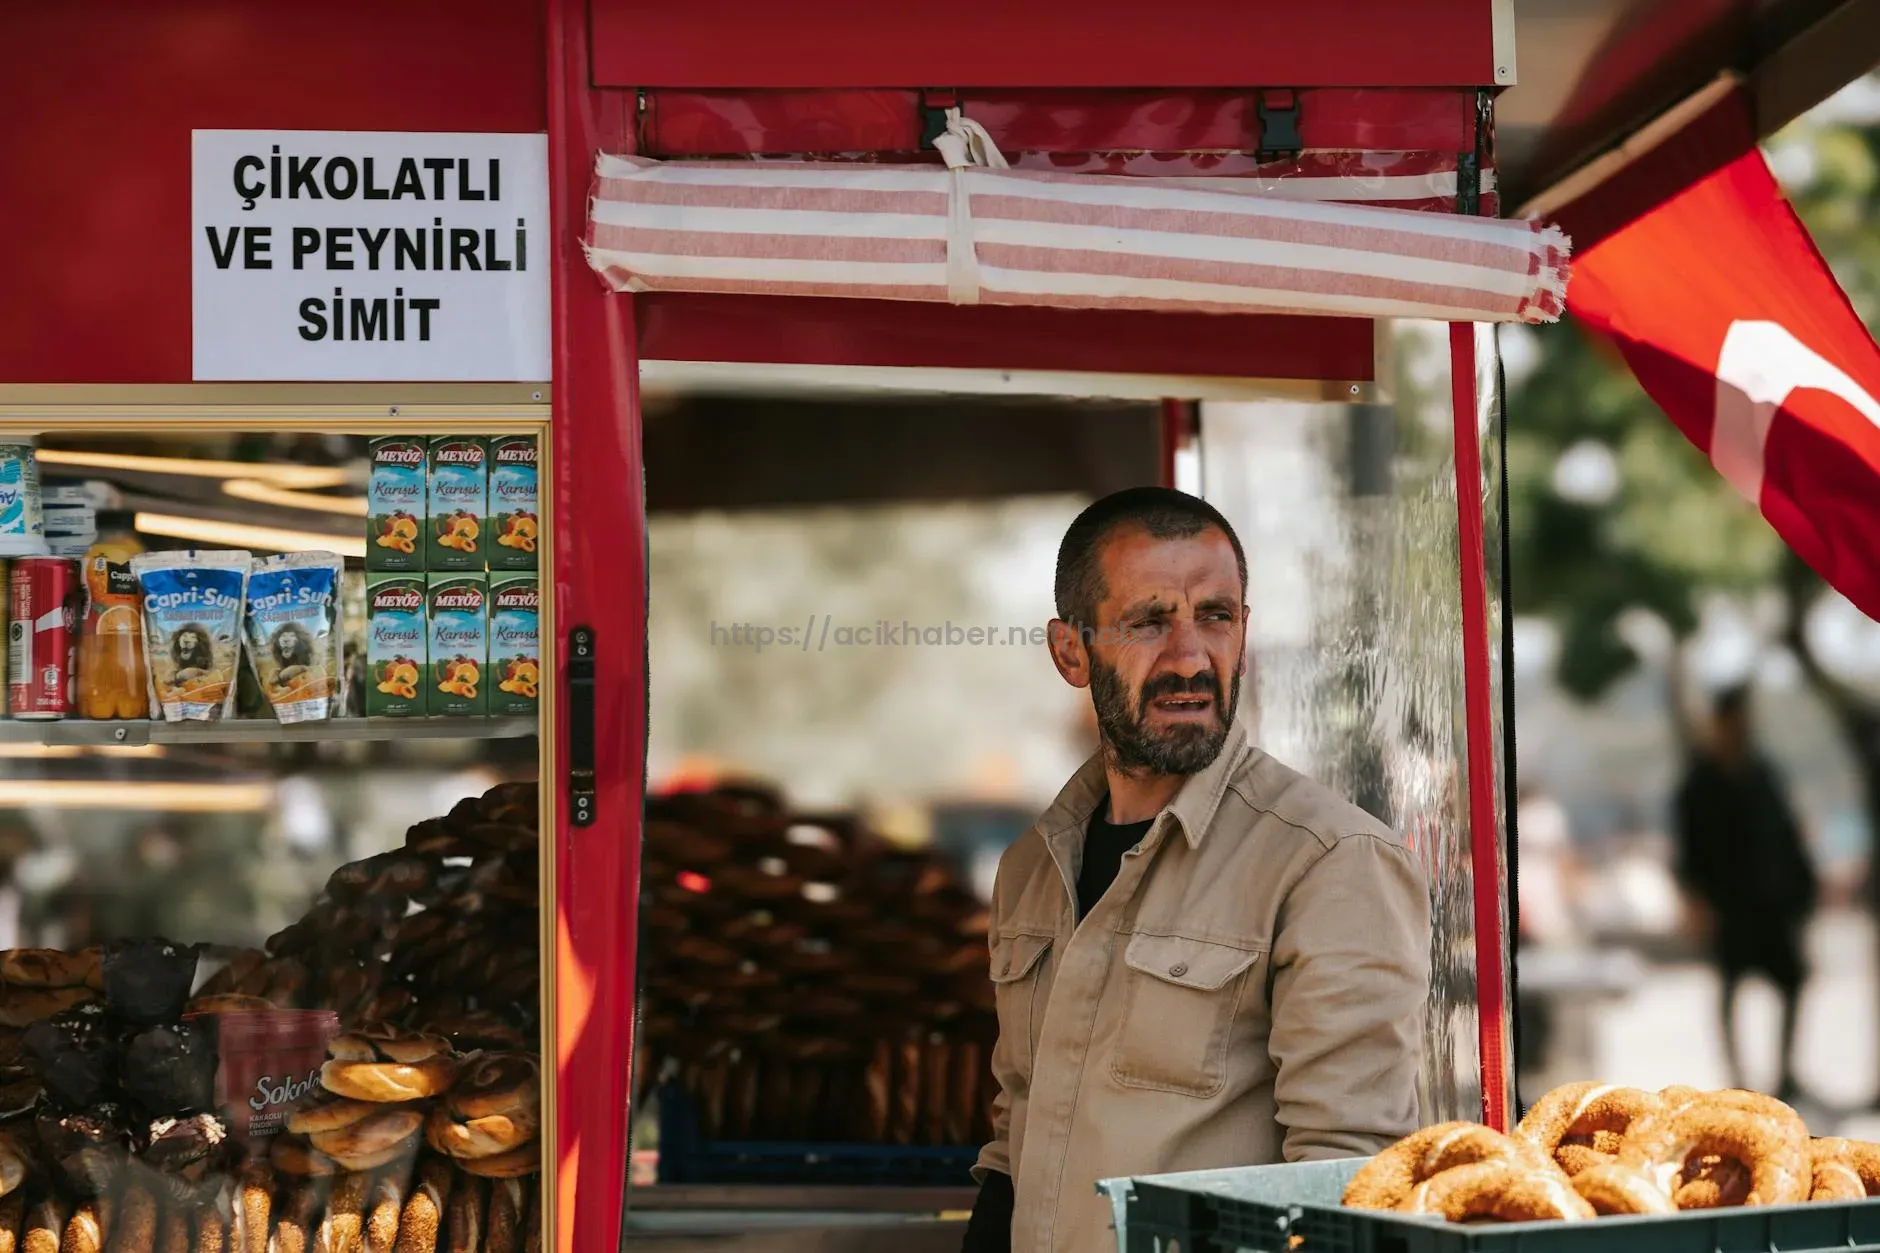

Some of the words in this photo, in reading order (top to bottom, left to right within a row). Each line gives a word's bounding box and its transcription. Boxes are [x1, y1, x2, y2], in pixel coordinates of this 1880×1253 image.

[233, 145, 500, 210] ÇİKOLATLI
[205, 226, 272, 269] VE
[292, 217, 527, 271] PEYNİRLİ
[298, 287, 440, 341] SİMİT
[375, 449, 423, 463] MEYÖZ
[436, 449, 483, 463] MEYÖZ
[374, 481, 420, 496] Karışık
[435, 481, 481, 496] Karışık
[144, 586, 239, 614] Capri-Sun
[373, 593, 422, 607] MEYÖZ
[435, 593, 483, 607] MEYÖZ
[374, 626, 420, 641] Karışık
[435, 626, 481, 641] Karışık
